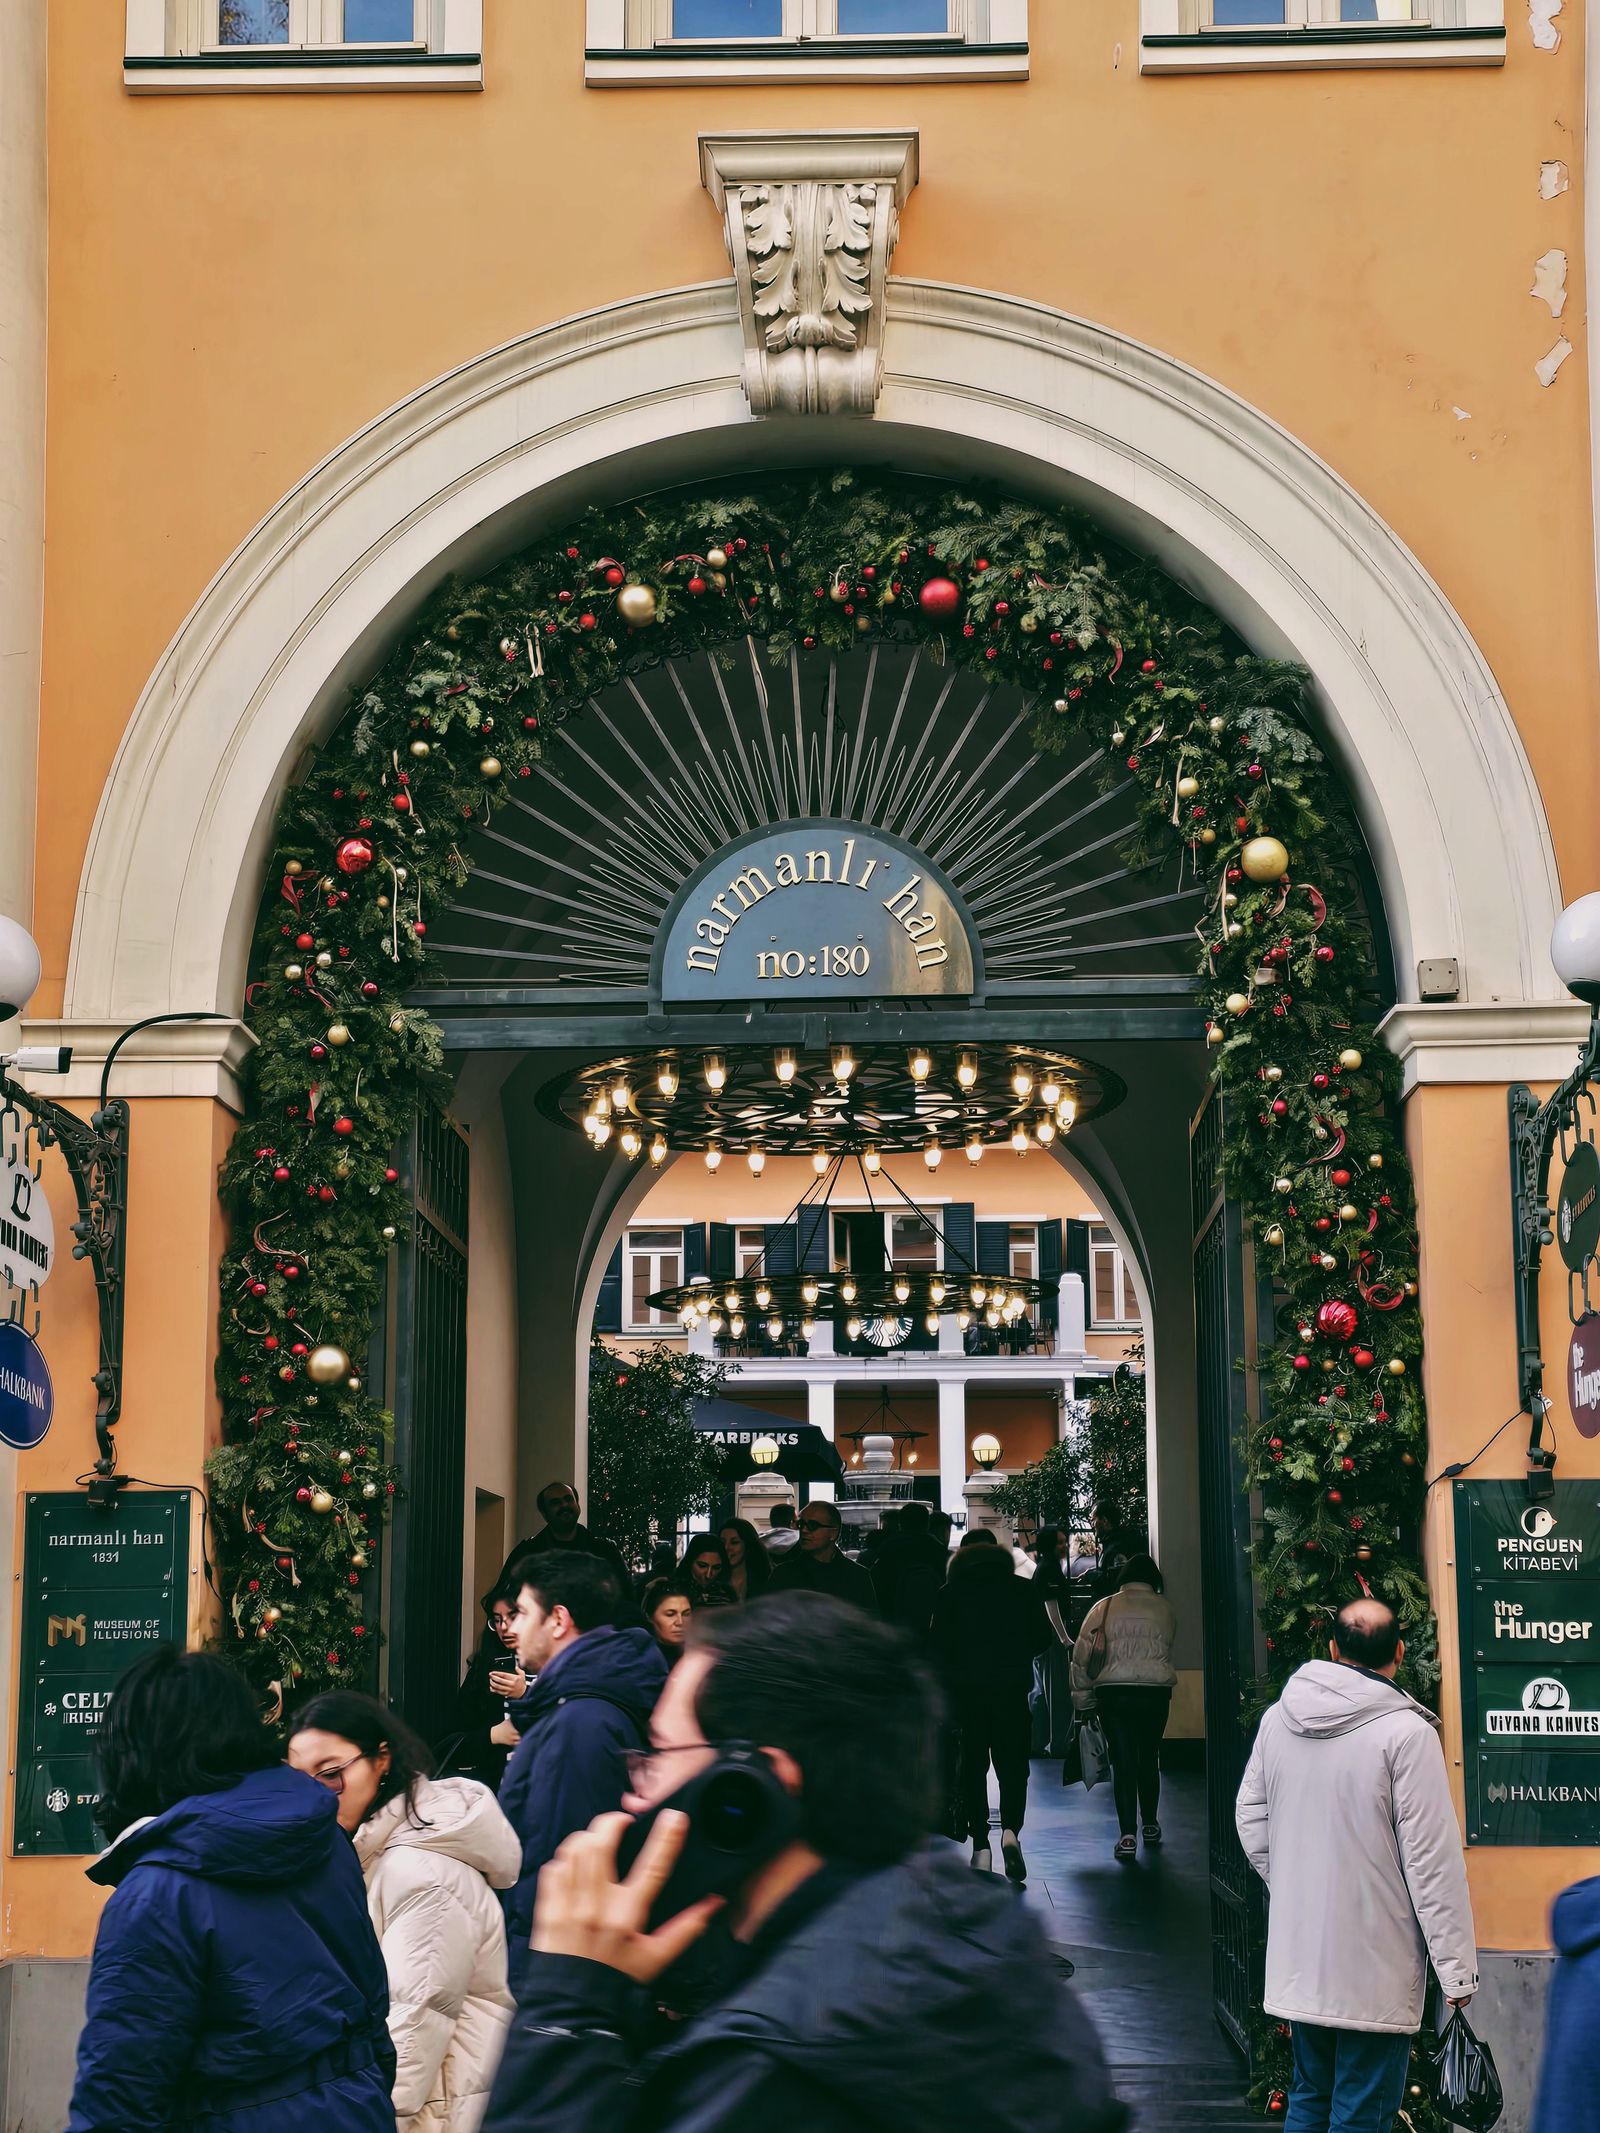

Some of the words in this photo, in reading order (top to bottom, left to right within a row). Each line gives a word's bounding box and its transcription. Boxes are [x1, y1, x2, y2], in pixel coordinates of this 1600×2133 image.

[882, 873, 949, 973] han
[756, 945, 870, 979] no:180
[1575, 1369, 1600, 1411] Hunge
[133, 1529, 164, 1545] han
[1497, 1538, 1583, 1553] PENGUEN
[92, 1551, 120, 1563] 1831
[1503, 1554, 1578, 1571] KİTABEVİ
[1494, 1600, 1524, 1616] the
[94, 1619, 141, 1629] MUSEUM
[145, 1619, 160, 1629] OF
[1495, 1617, 1593, 1644] Hunger
[93, 1630, 160, 1640] ILLUSIONS
[62, 1692, 114, 1709] CELT
[1546, 1715, 1599, 1732] KAHVES
[1511, 1786, 1600, 1802] HALKBAN
